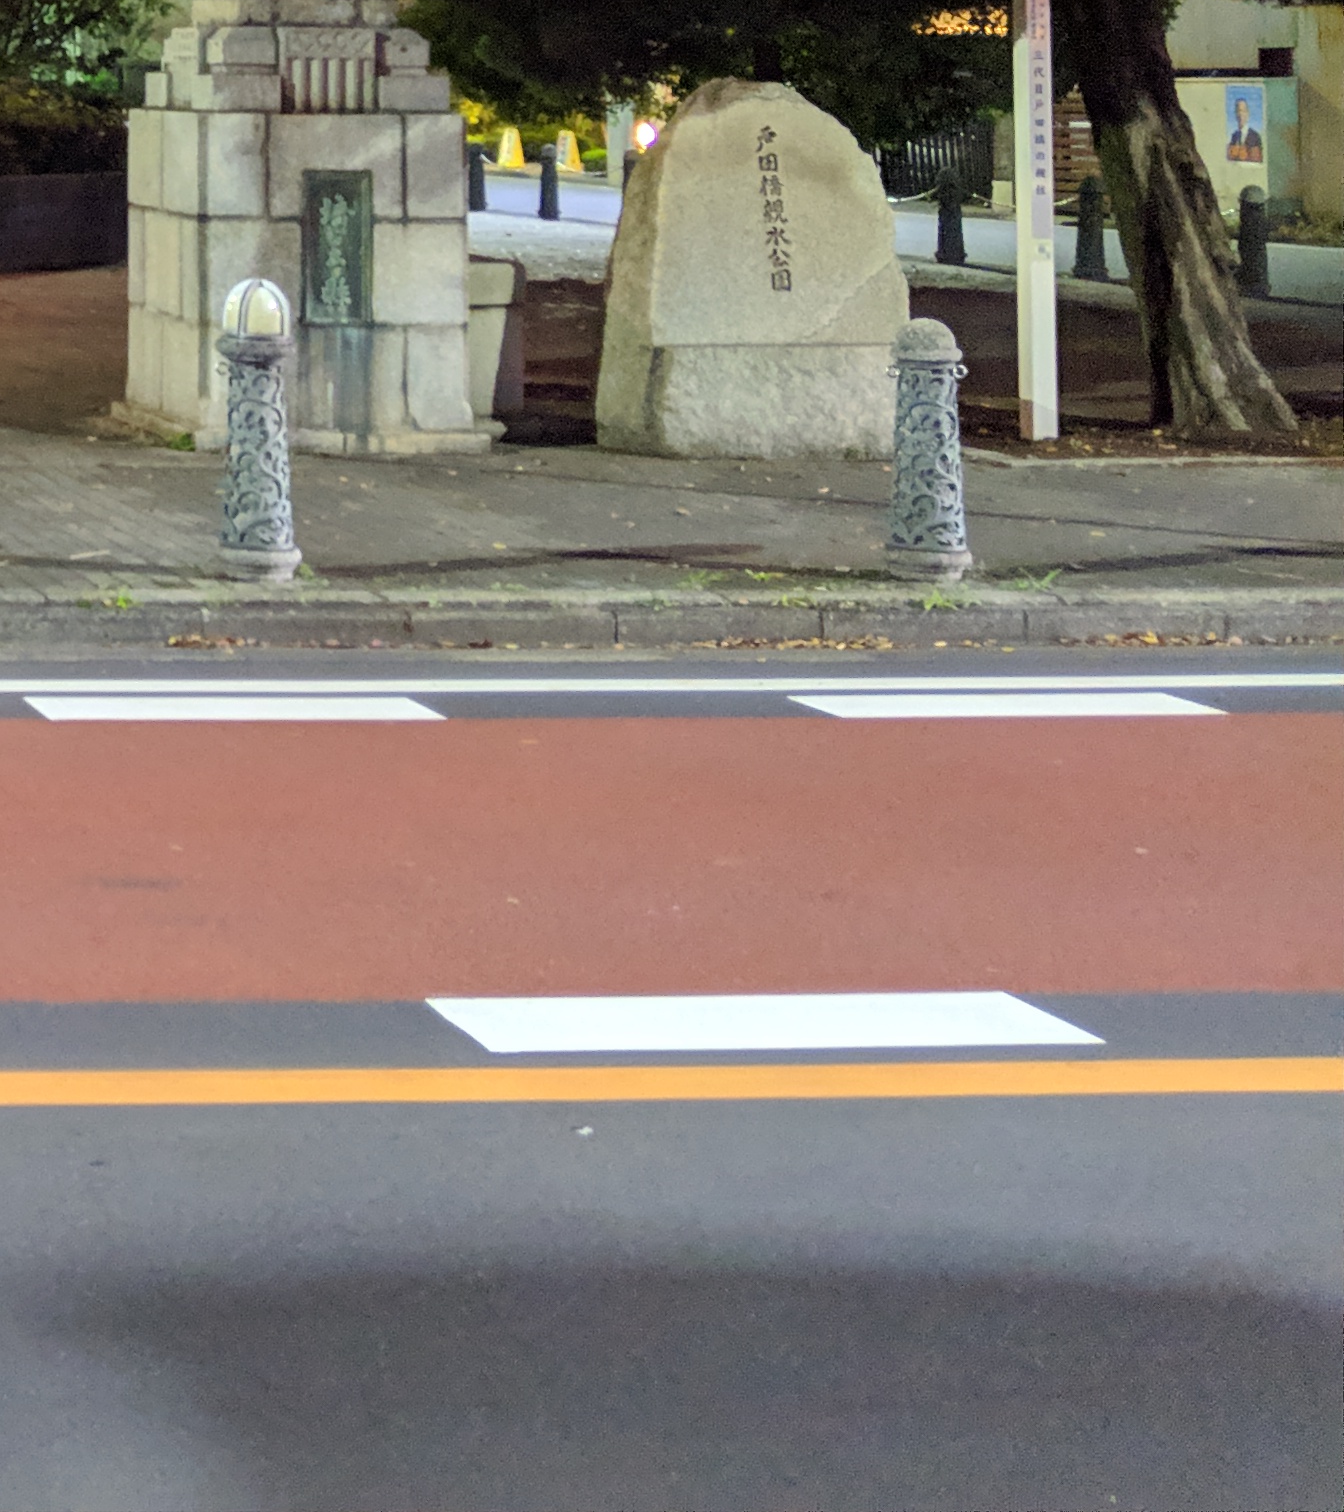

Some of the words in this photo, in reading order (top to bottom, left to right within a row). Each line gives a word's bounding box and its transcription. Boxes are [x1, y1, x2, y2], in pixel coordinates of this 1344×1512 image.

[756, 125, 792, 292] 戸田橋親水公園
